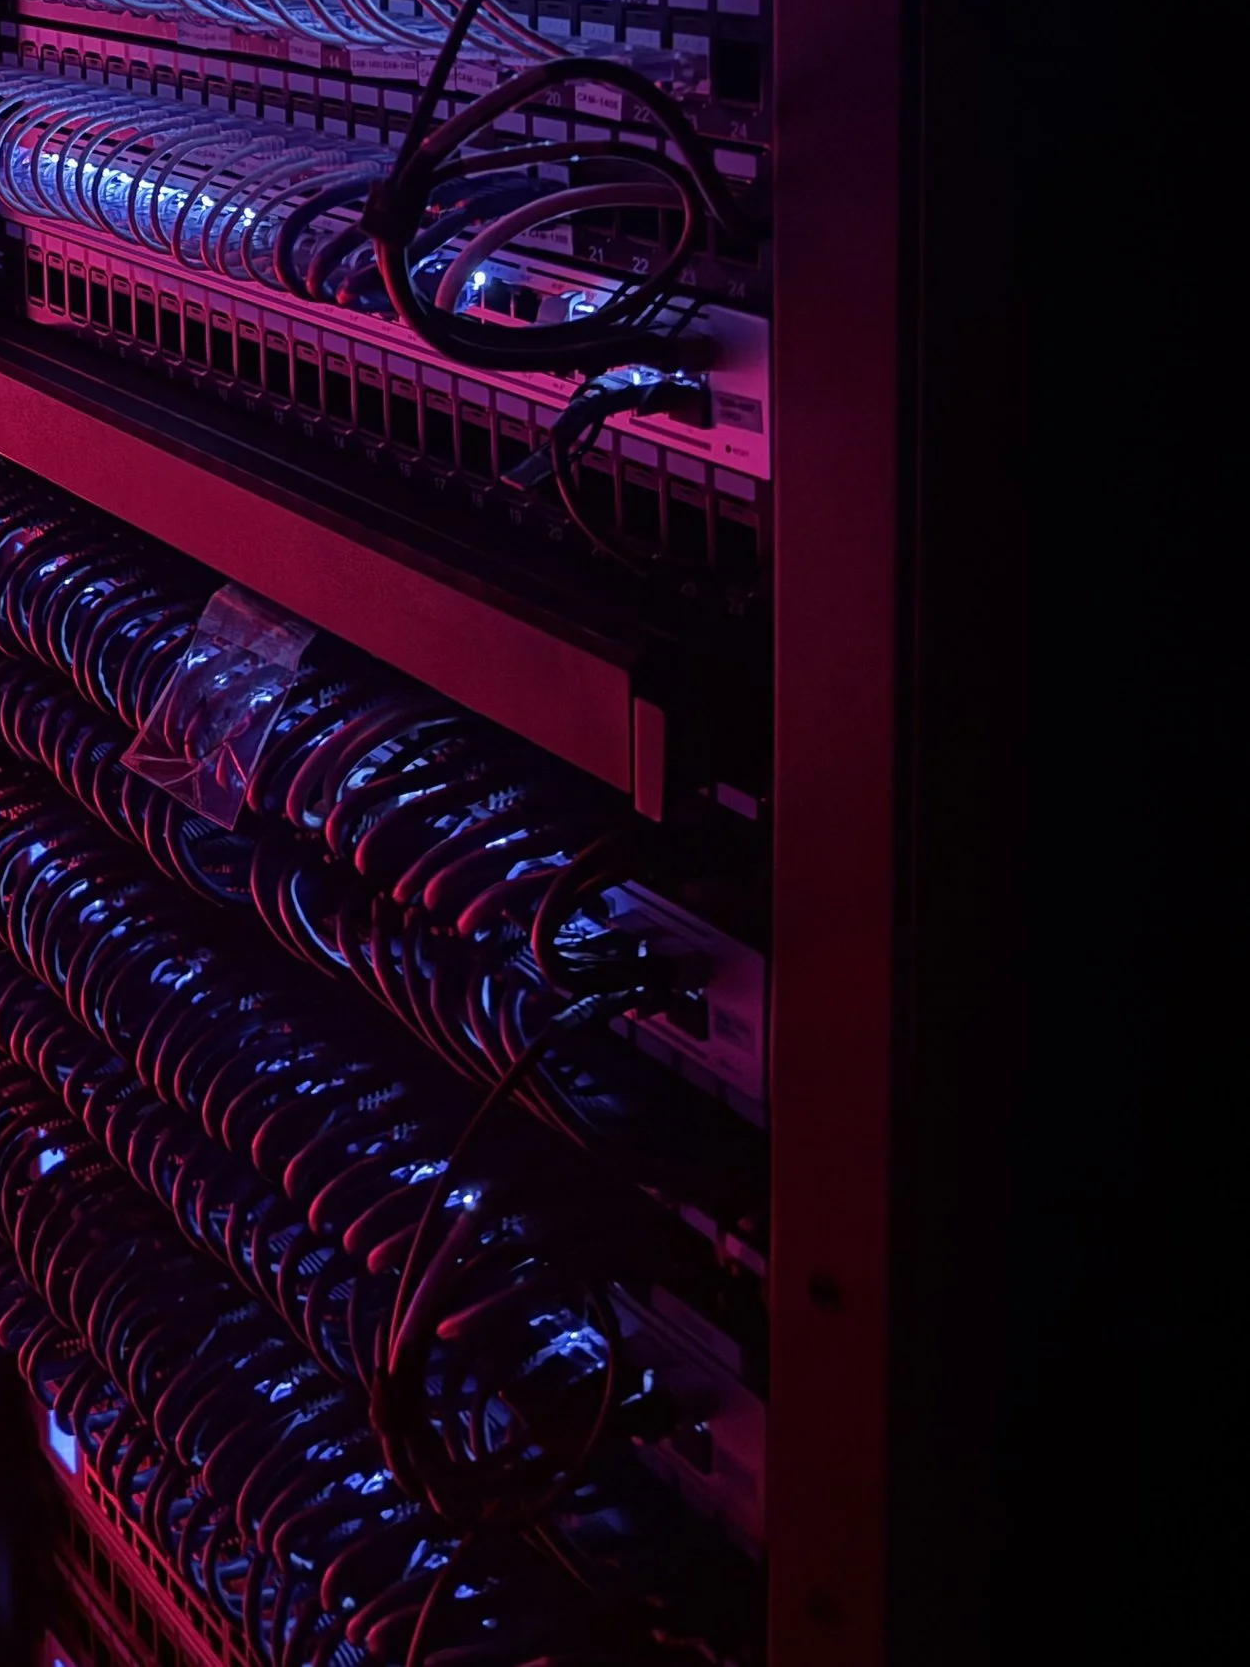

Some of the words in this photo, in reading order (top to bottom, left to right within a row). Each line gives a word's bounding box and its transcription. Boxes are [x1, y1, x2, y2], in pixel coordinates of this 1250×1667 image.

[545, 91, 561, 108] 20
[632, 104, 651, 124] 22
[729, 119, 748, 141] 24
[588, 245, 604, 264] 21
[631, 256, 650, 275] 22
[727, 279, 746, 299] 24
[433, 476, 447, 491] 17
